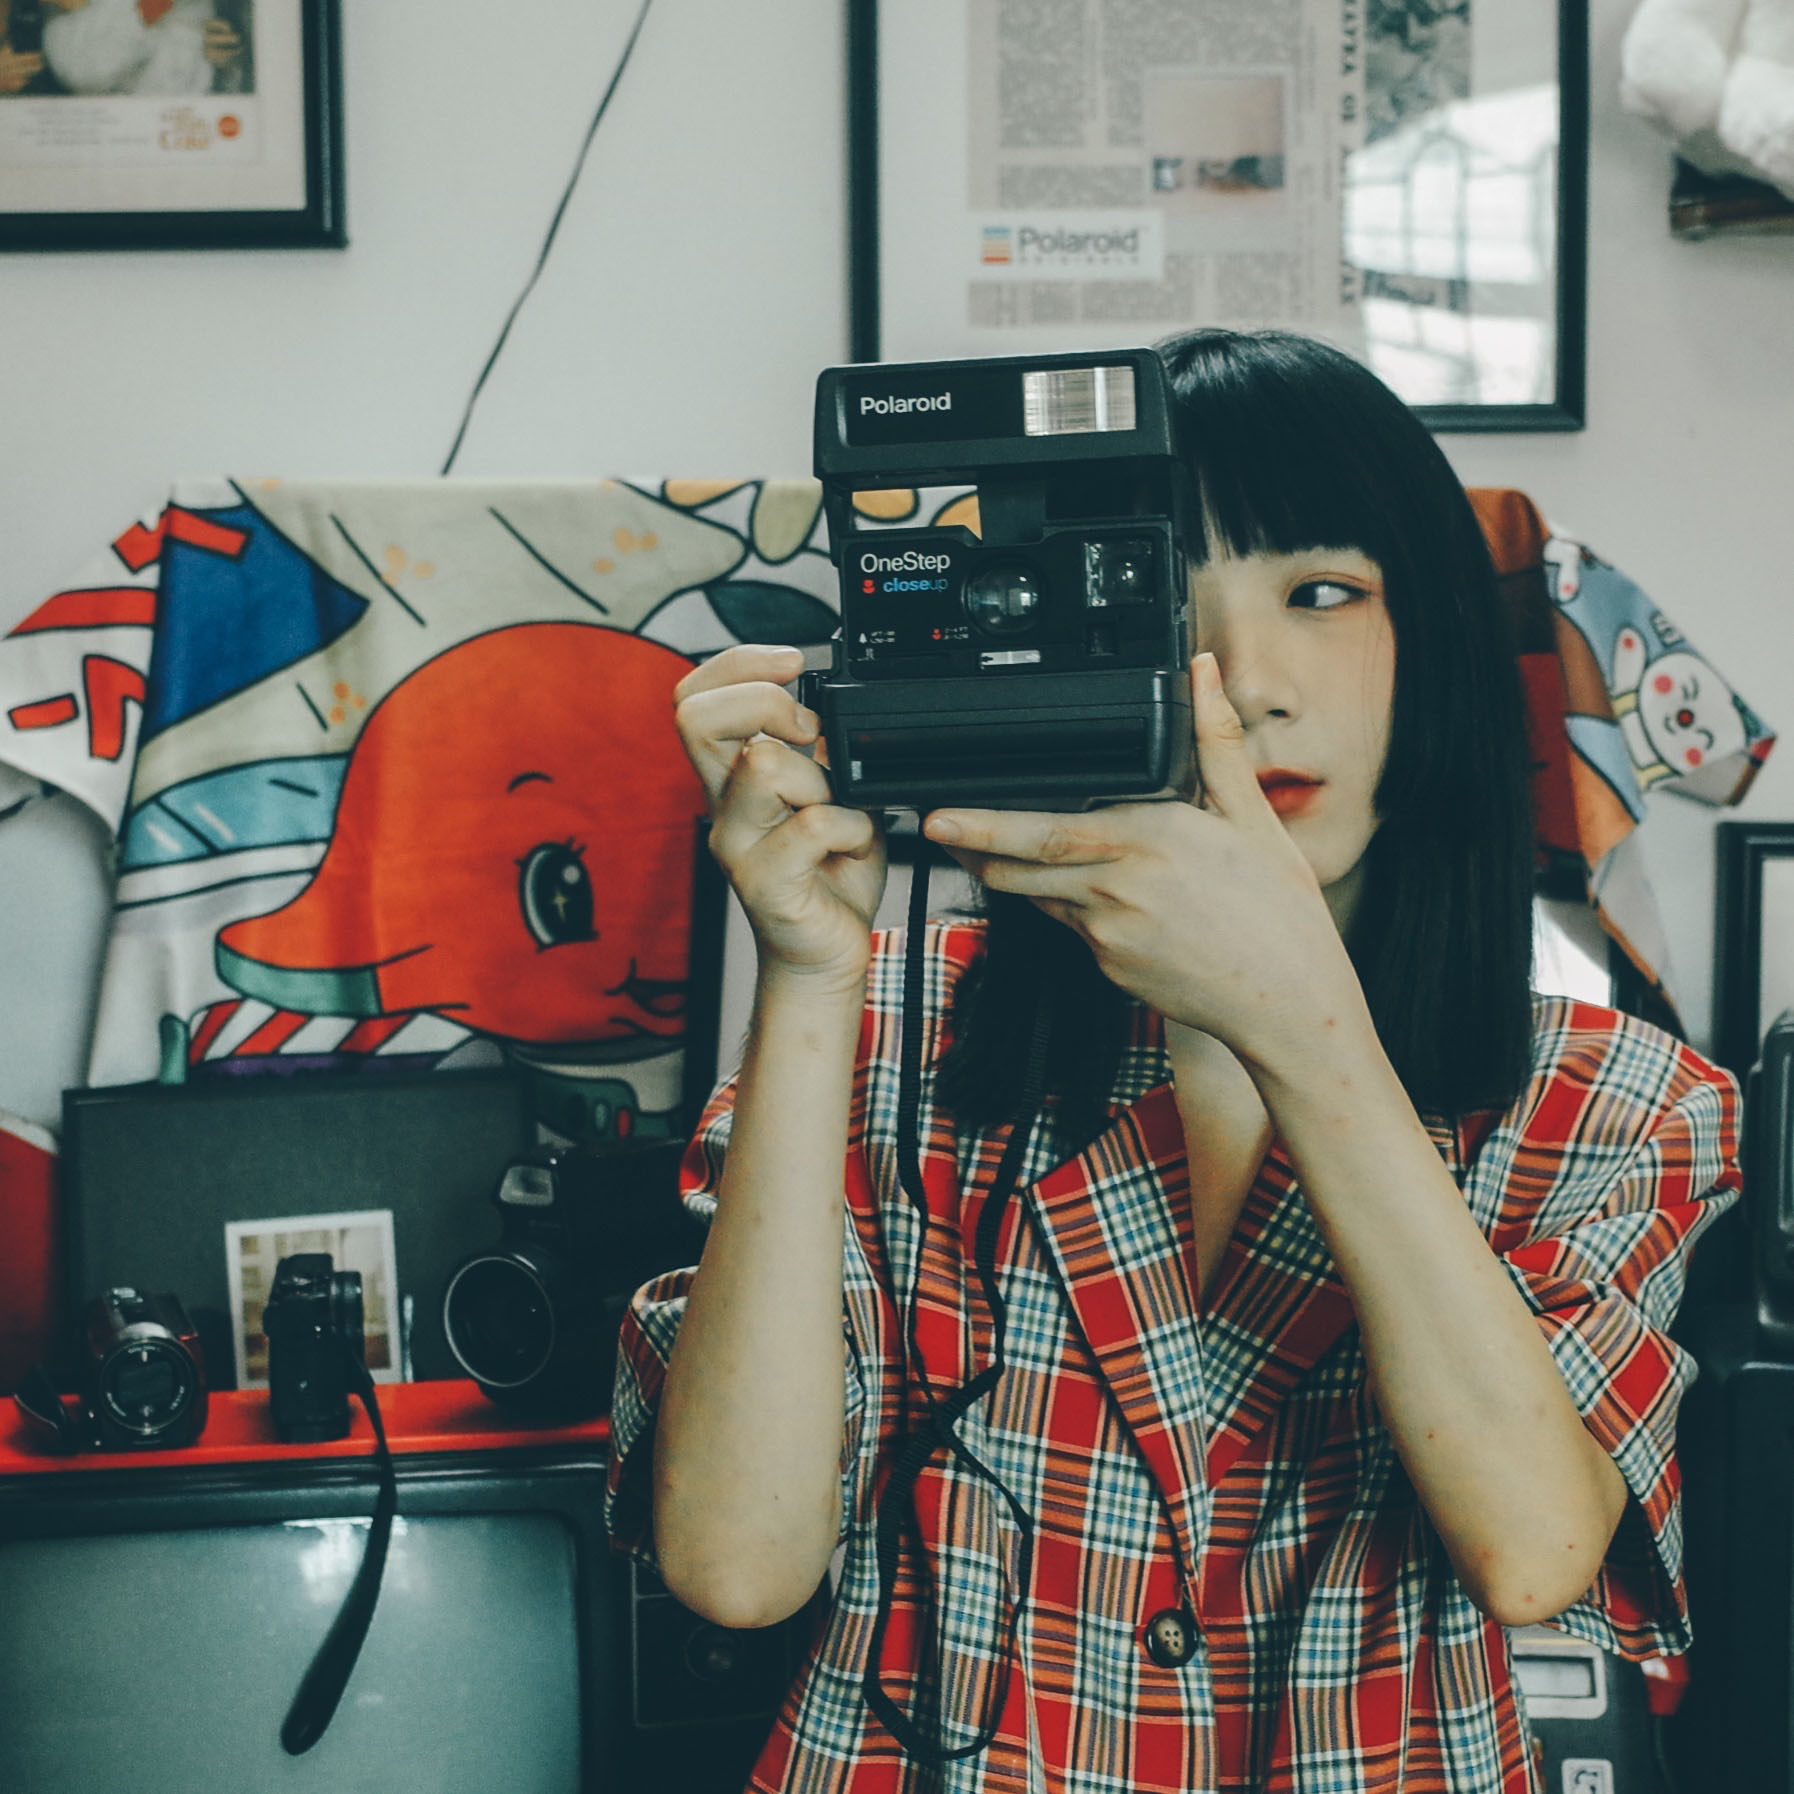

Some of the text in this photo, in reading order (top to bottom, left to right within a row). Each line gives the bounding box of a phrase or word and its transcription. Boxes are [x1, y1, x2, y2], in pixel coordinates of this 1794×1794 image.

[1018, 226, 1139, 253] Polaroid
[860, 392, 952, 415] Polaroid
[860, 551, 951, 573] OneStep
[883, 578, 949, 592] closeup
